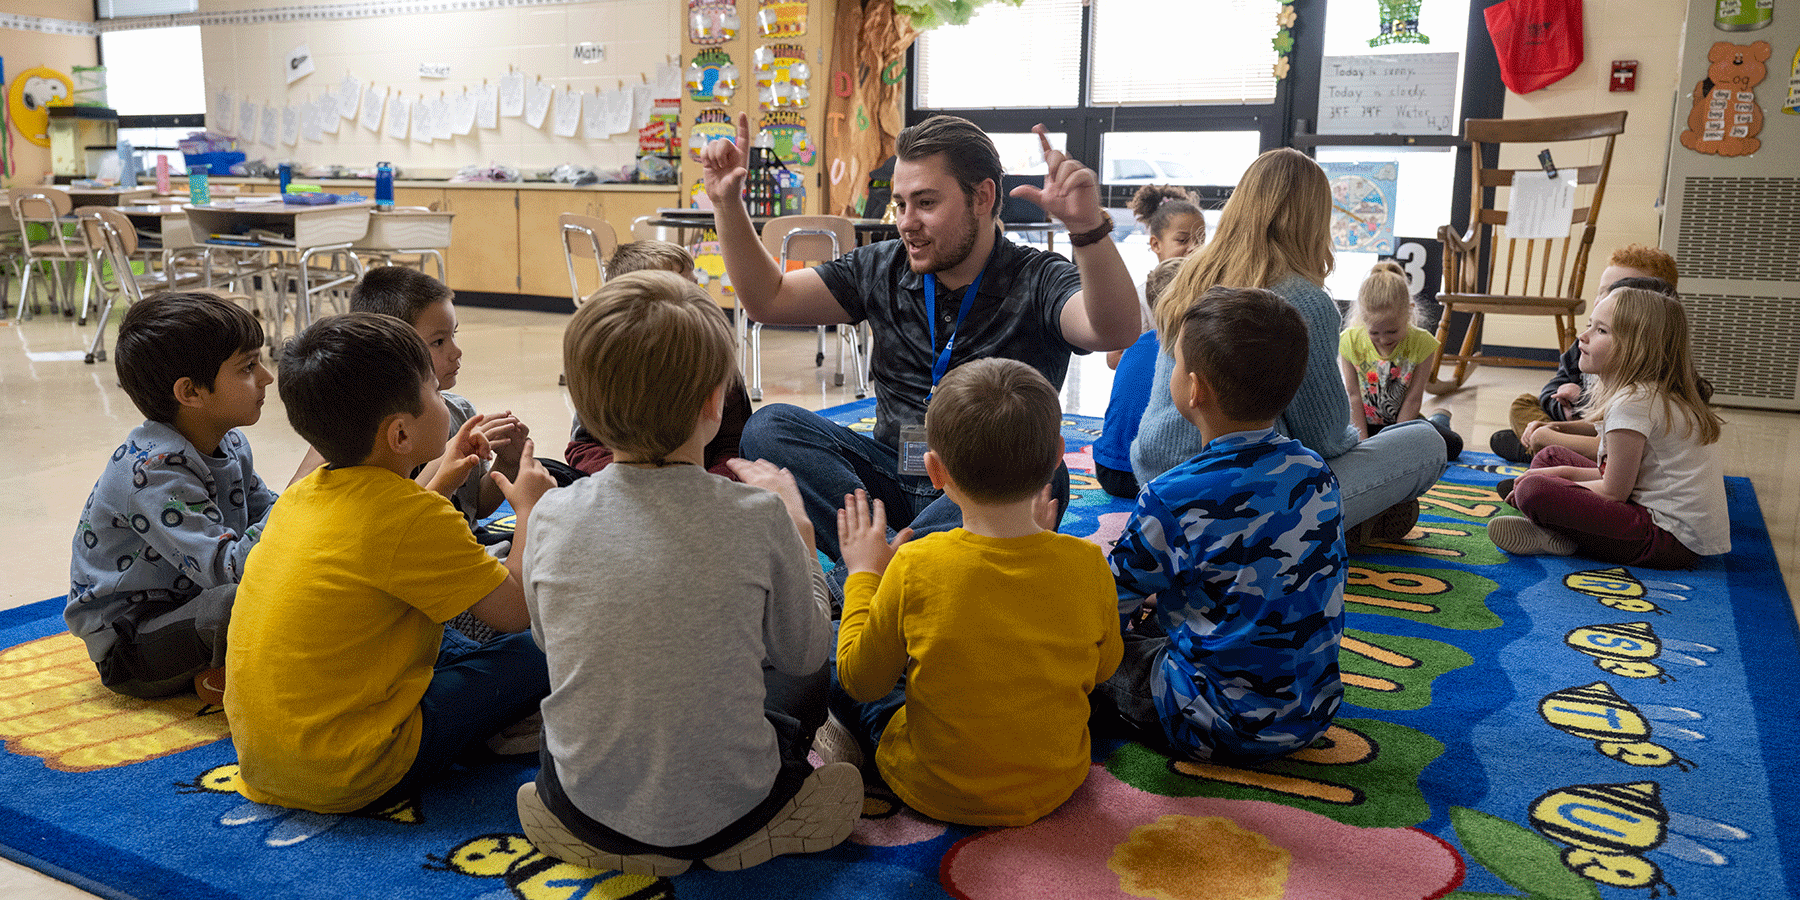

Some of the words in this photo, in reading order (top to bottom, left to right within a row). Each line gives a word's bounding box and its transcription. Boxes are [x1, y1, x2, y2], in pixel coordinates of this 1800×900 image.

[573, 45, 604, 59] Math
[1333, 64, 1364, 81] Today
[1327, 85, 1363, 103] Today
[1395, 104, 1431, 119] Water
[1396, 241, 1428, 297] 3
[1577, 578, 1632, 592] R
[1585, 633, 1643, 652] S
[1551, 706, 1623, 730] T
[1557, 802, 1641, 838] U
